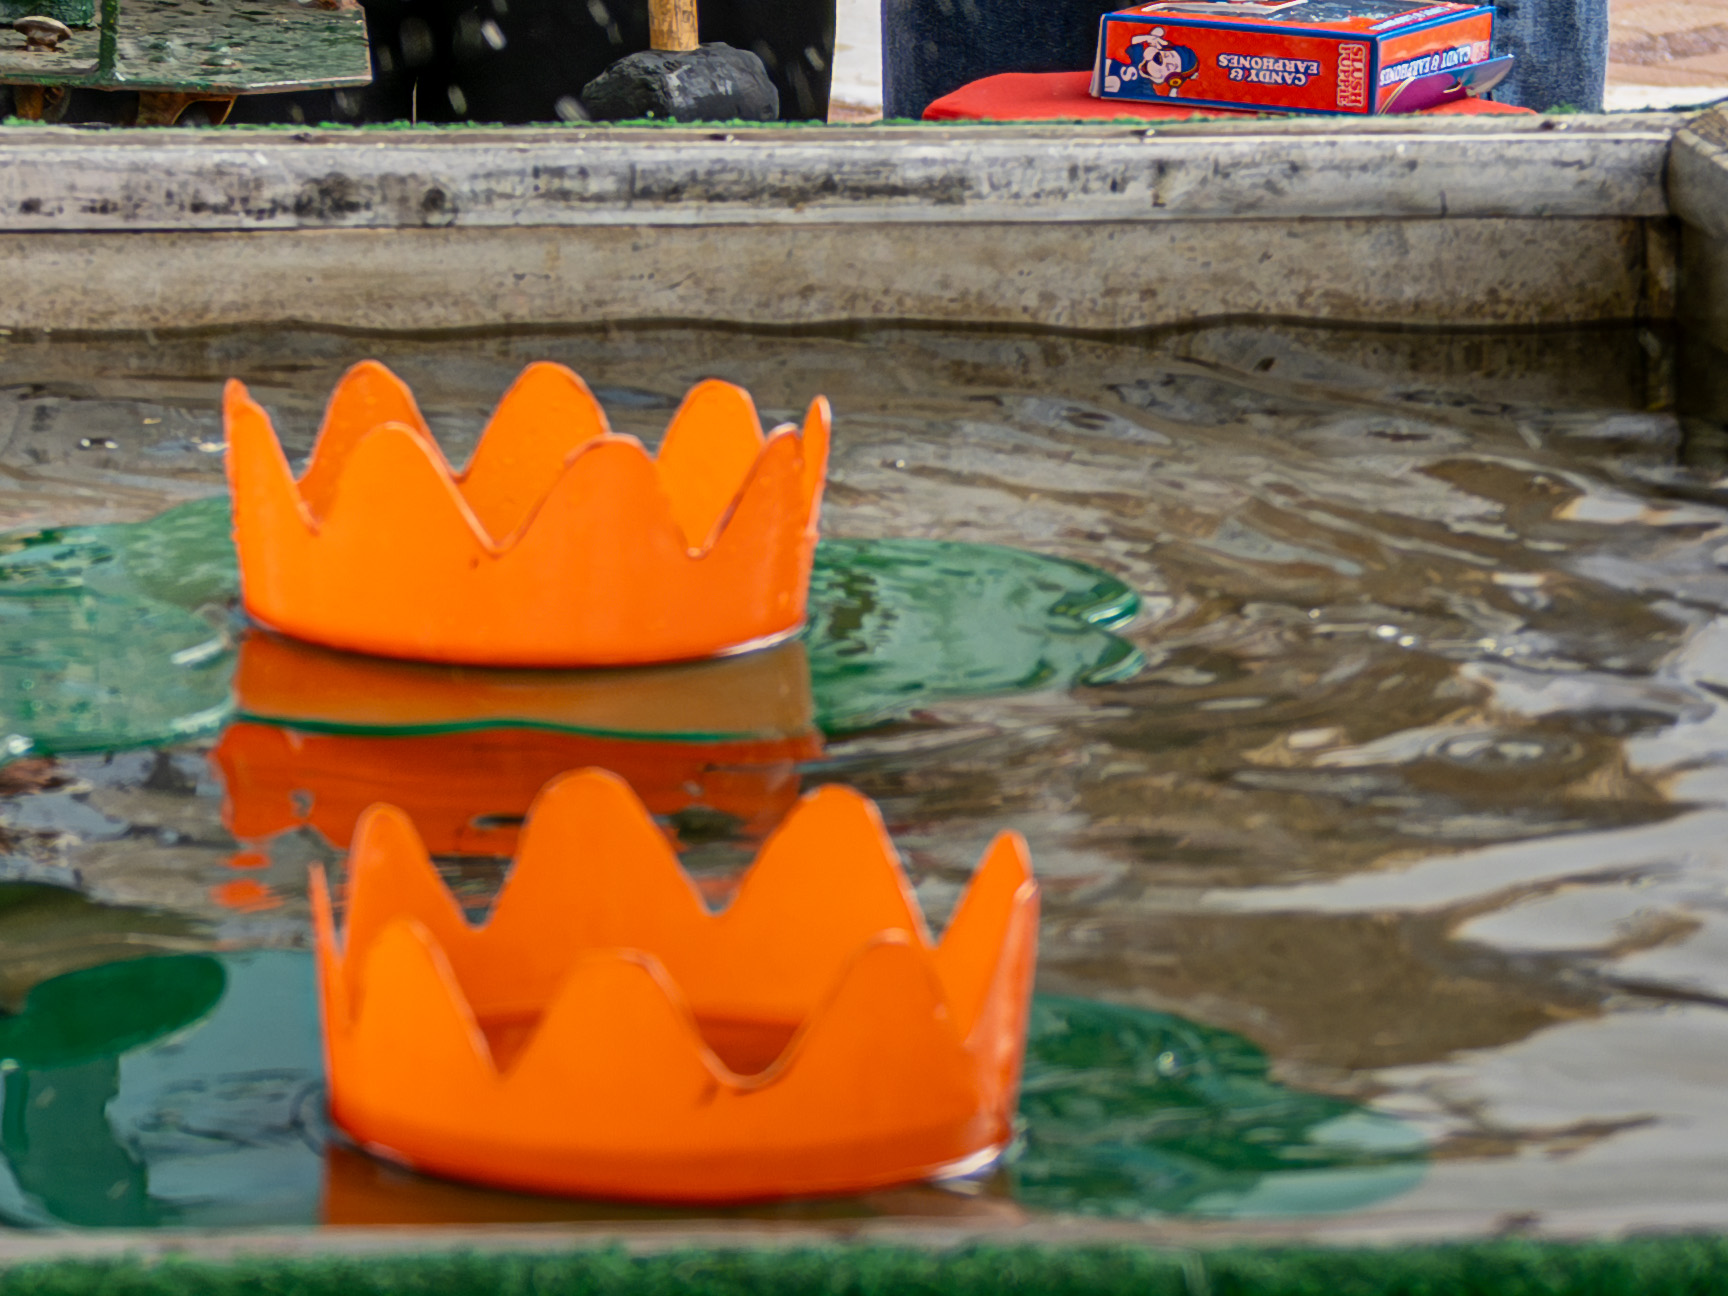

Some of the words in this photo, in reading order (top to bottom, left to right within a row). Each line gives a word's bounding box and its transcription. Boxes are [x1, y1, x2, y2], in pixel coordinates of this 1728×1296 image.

[1217, 53, 1320, 74] EARPHONES
[1229, 67, 1244, 81] &
[1246, 69, 1307, 86] CANDY
[1350, 43, 1366, 107] SLUSH
